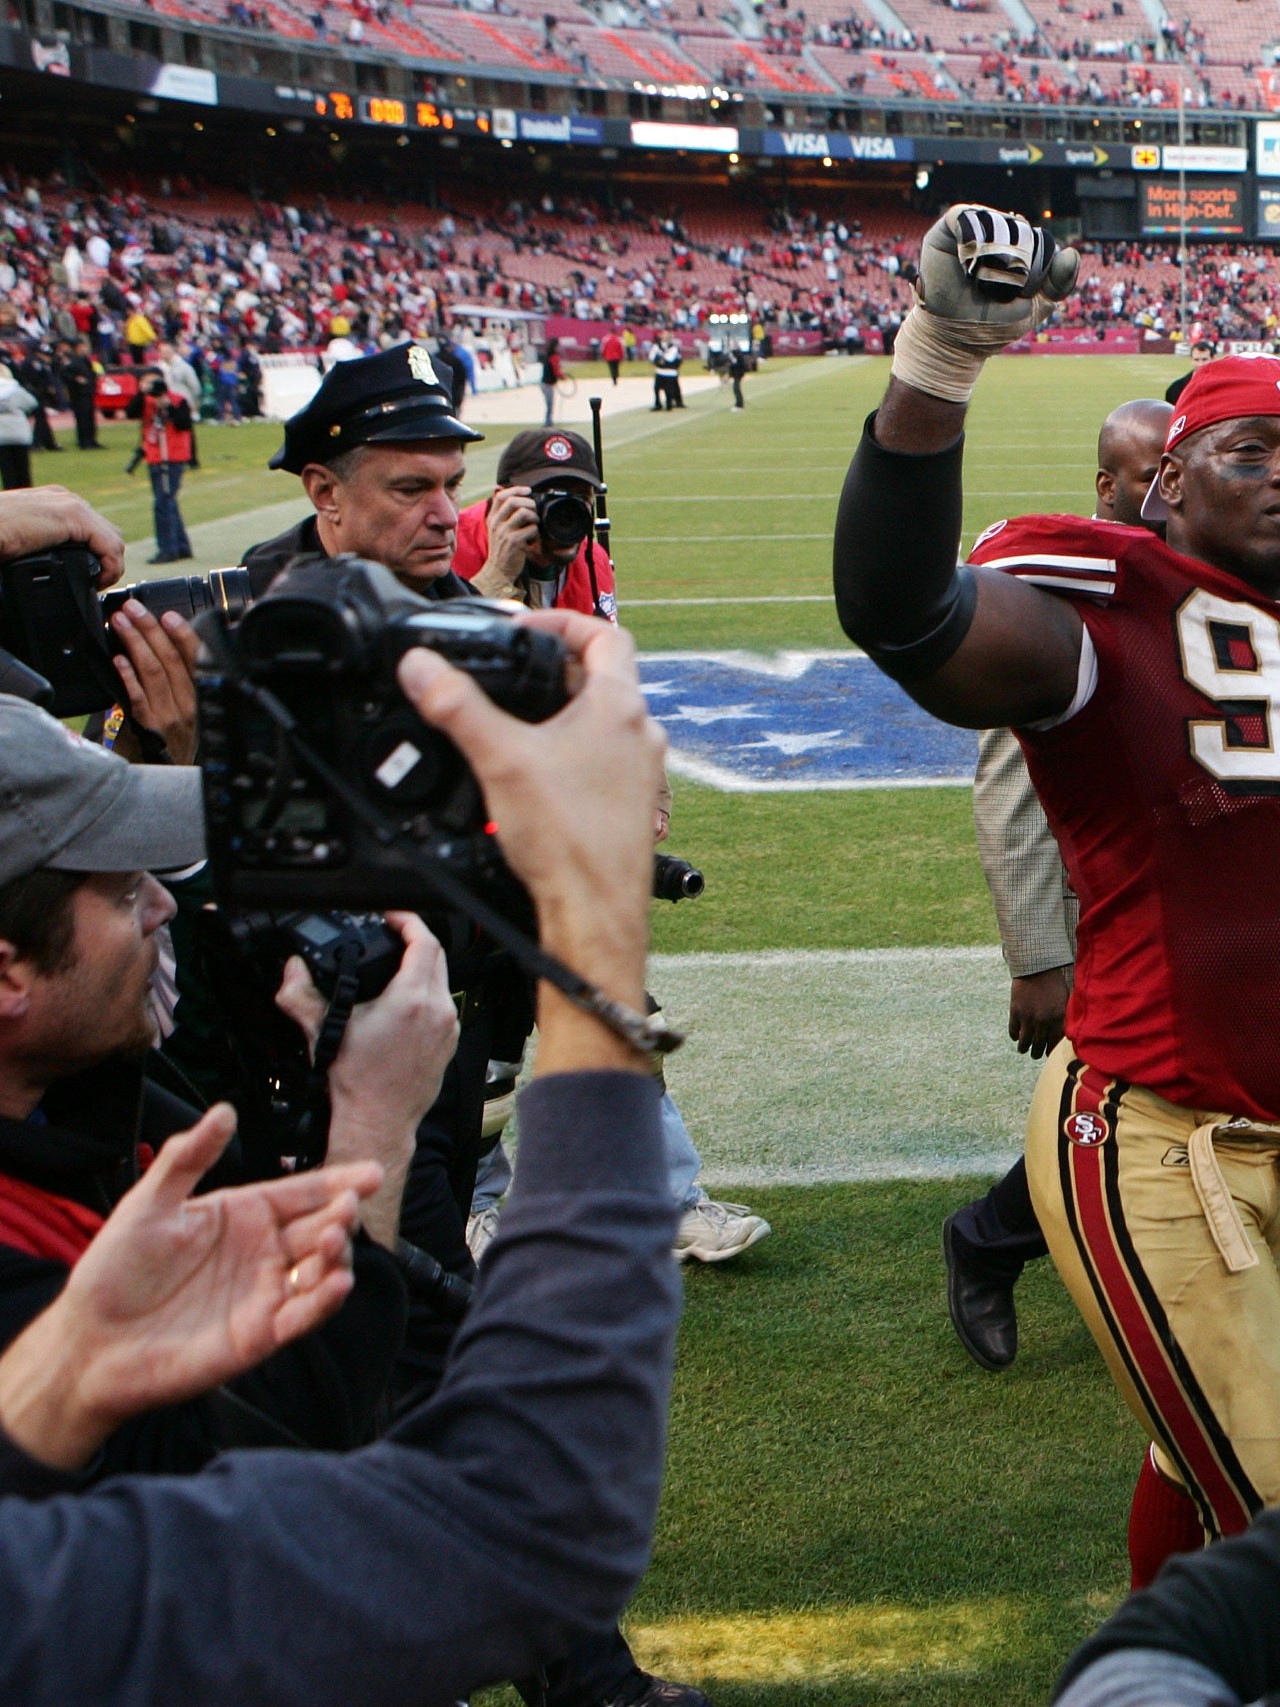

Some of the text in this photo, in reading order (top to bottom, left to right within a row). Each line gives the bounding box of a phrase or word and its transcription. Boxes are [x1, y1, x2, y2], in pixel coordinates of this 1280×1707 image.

[781, 132, 896, 158] VISA VISA
[1147, 187, 1238, 204] More sports
[1148, 203, 1234, 220] in High-Def.
